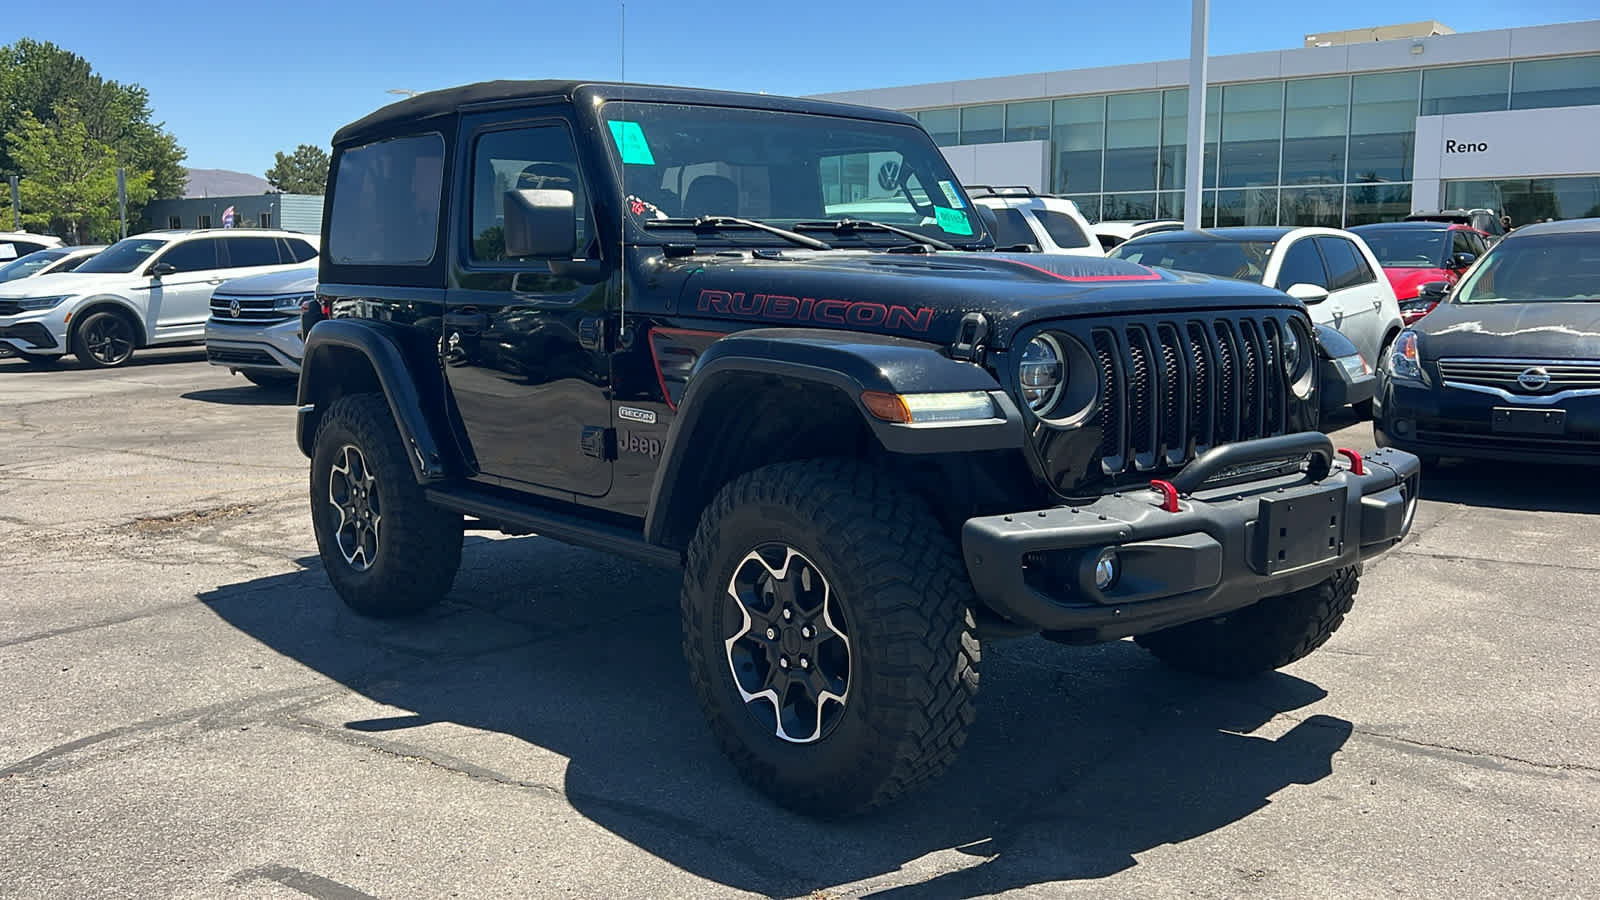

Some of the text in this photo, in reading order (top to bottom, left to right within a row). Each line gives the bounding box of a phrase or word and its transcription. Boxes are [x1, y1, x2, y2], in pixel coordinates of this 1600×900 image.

[1446, 139, 1488, 153] Reno
[697, 289, 934, 332] RUBICON
[621, 409, 653, 420] RECON
[618, 430, 661, 461] Jeep
